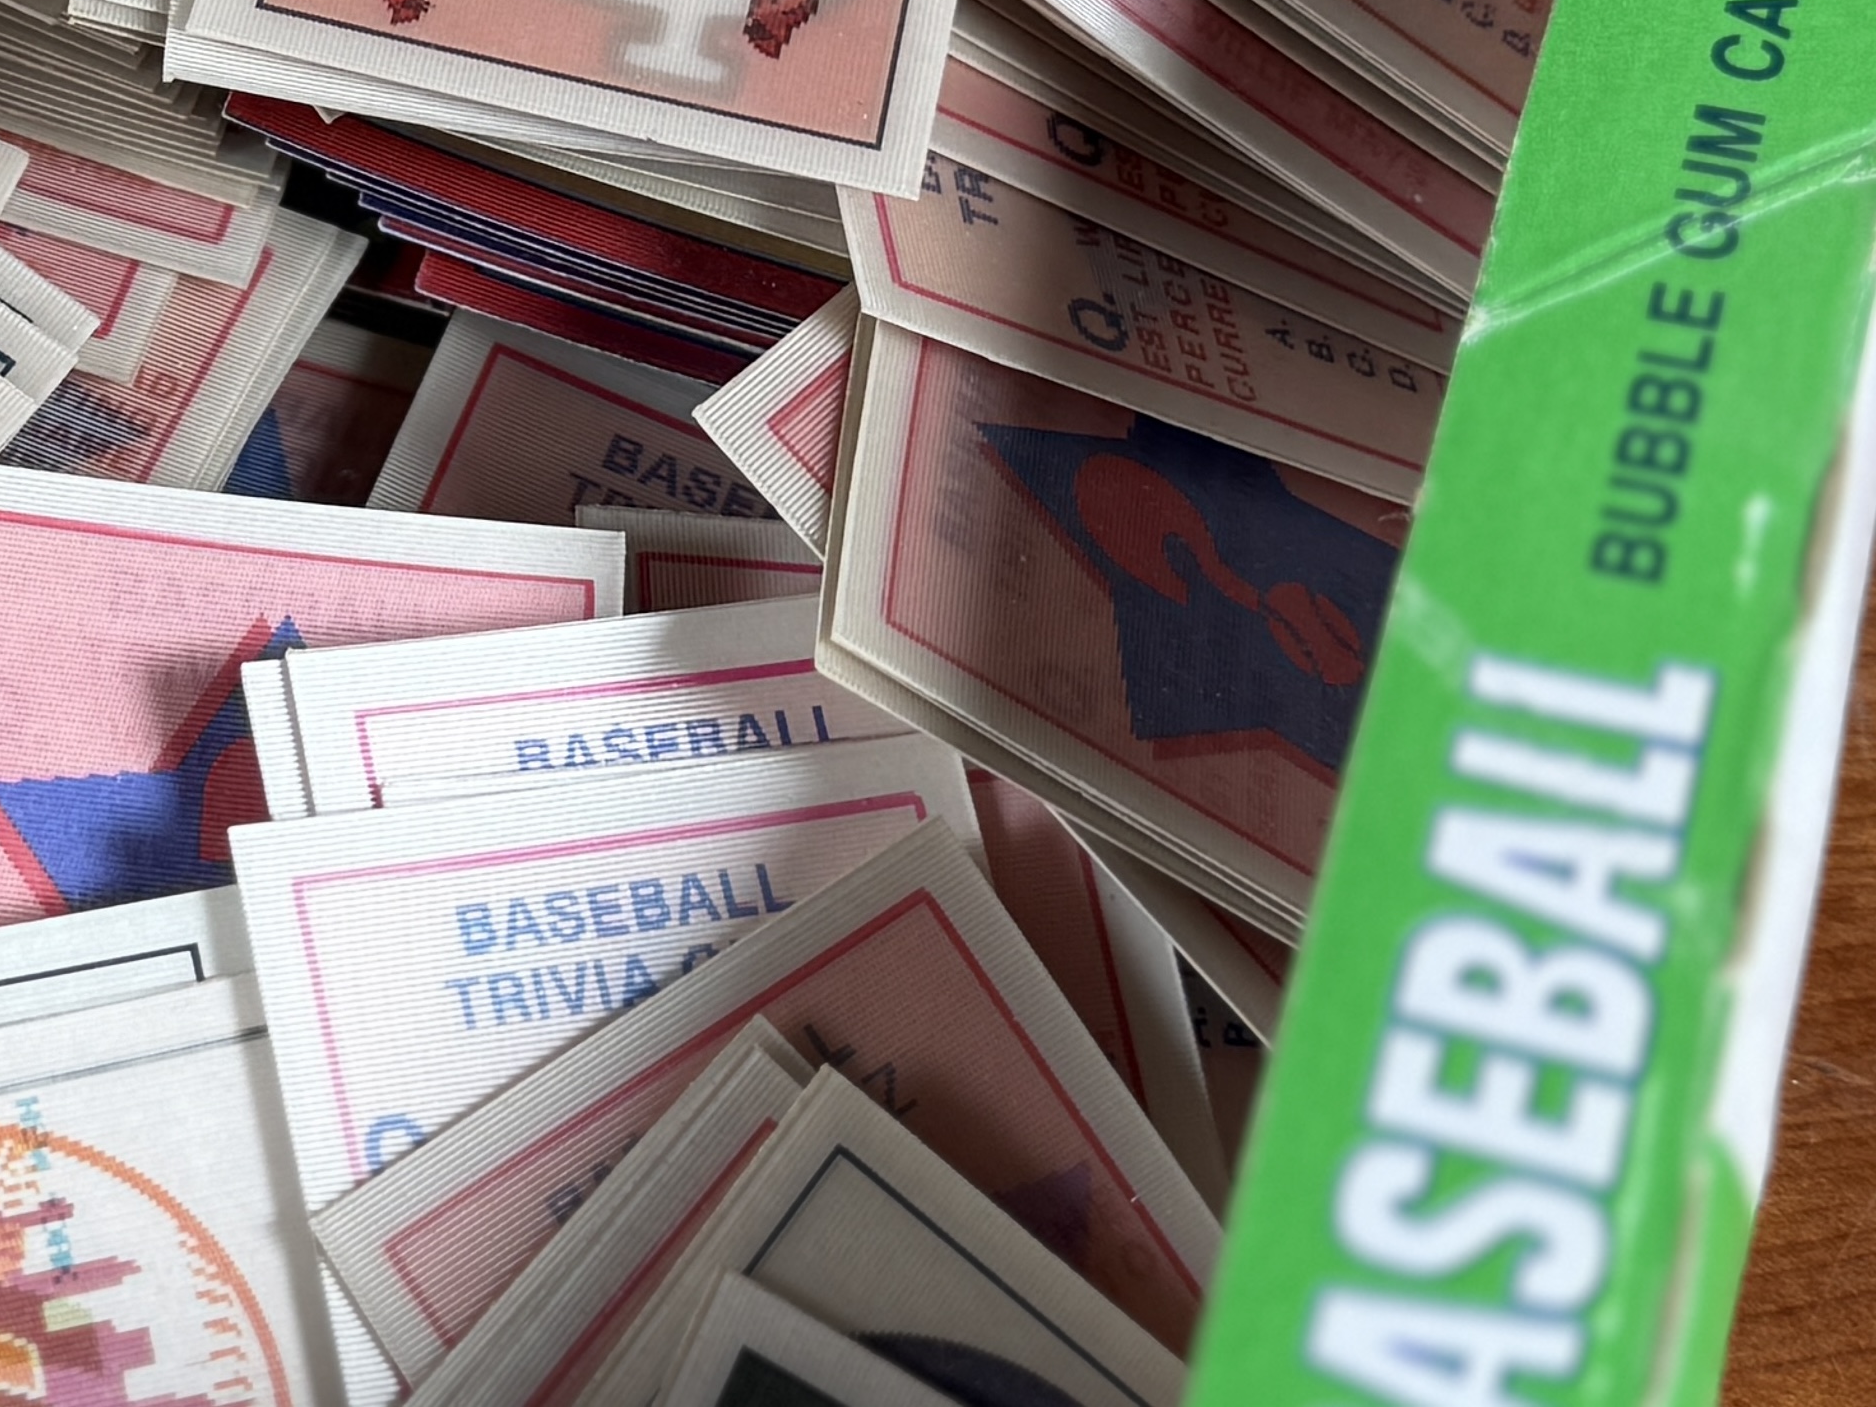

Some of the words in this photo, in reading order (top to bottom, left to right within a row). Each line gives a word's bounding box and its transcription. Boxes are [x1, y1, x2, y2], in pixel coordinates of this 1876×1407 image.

[1067, 292, 1130, 352] Q.
[1130, 303, 1173, 374] EST
[1265, 318, 1295, 351] A.
[1589, 279, 1726, 584] BUBBLE
[1667, 101, 1767, 259] GUM
[601, 433, 784, 521] BASE
[454, 862, 797, 957] BASEBALL
[444, 952, 660, 1031] TRIVIA
[1303, 647, 1721, 1407] ASEBALL
